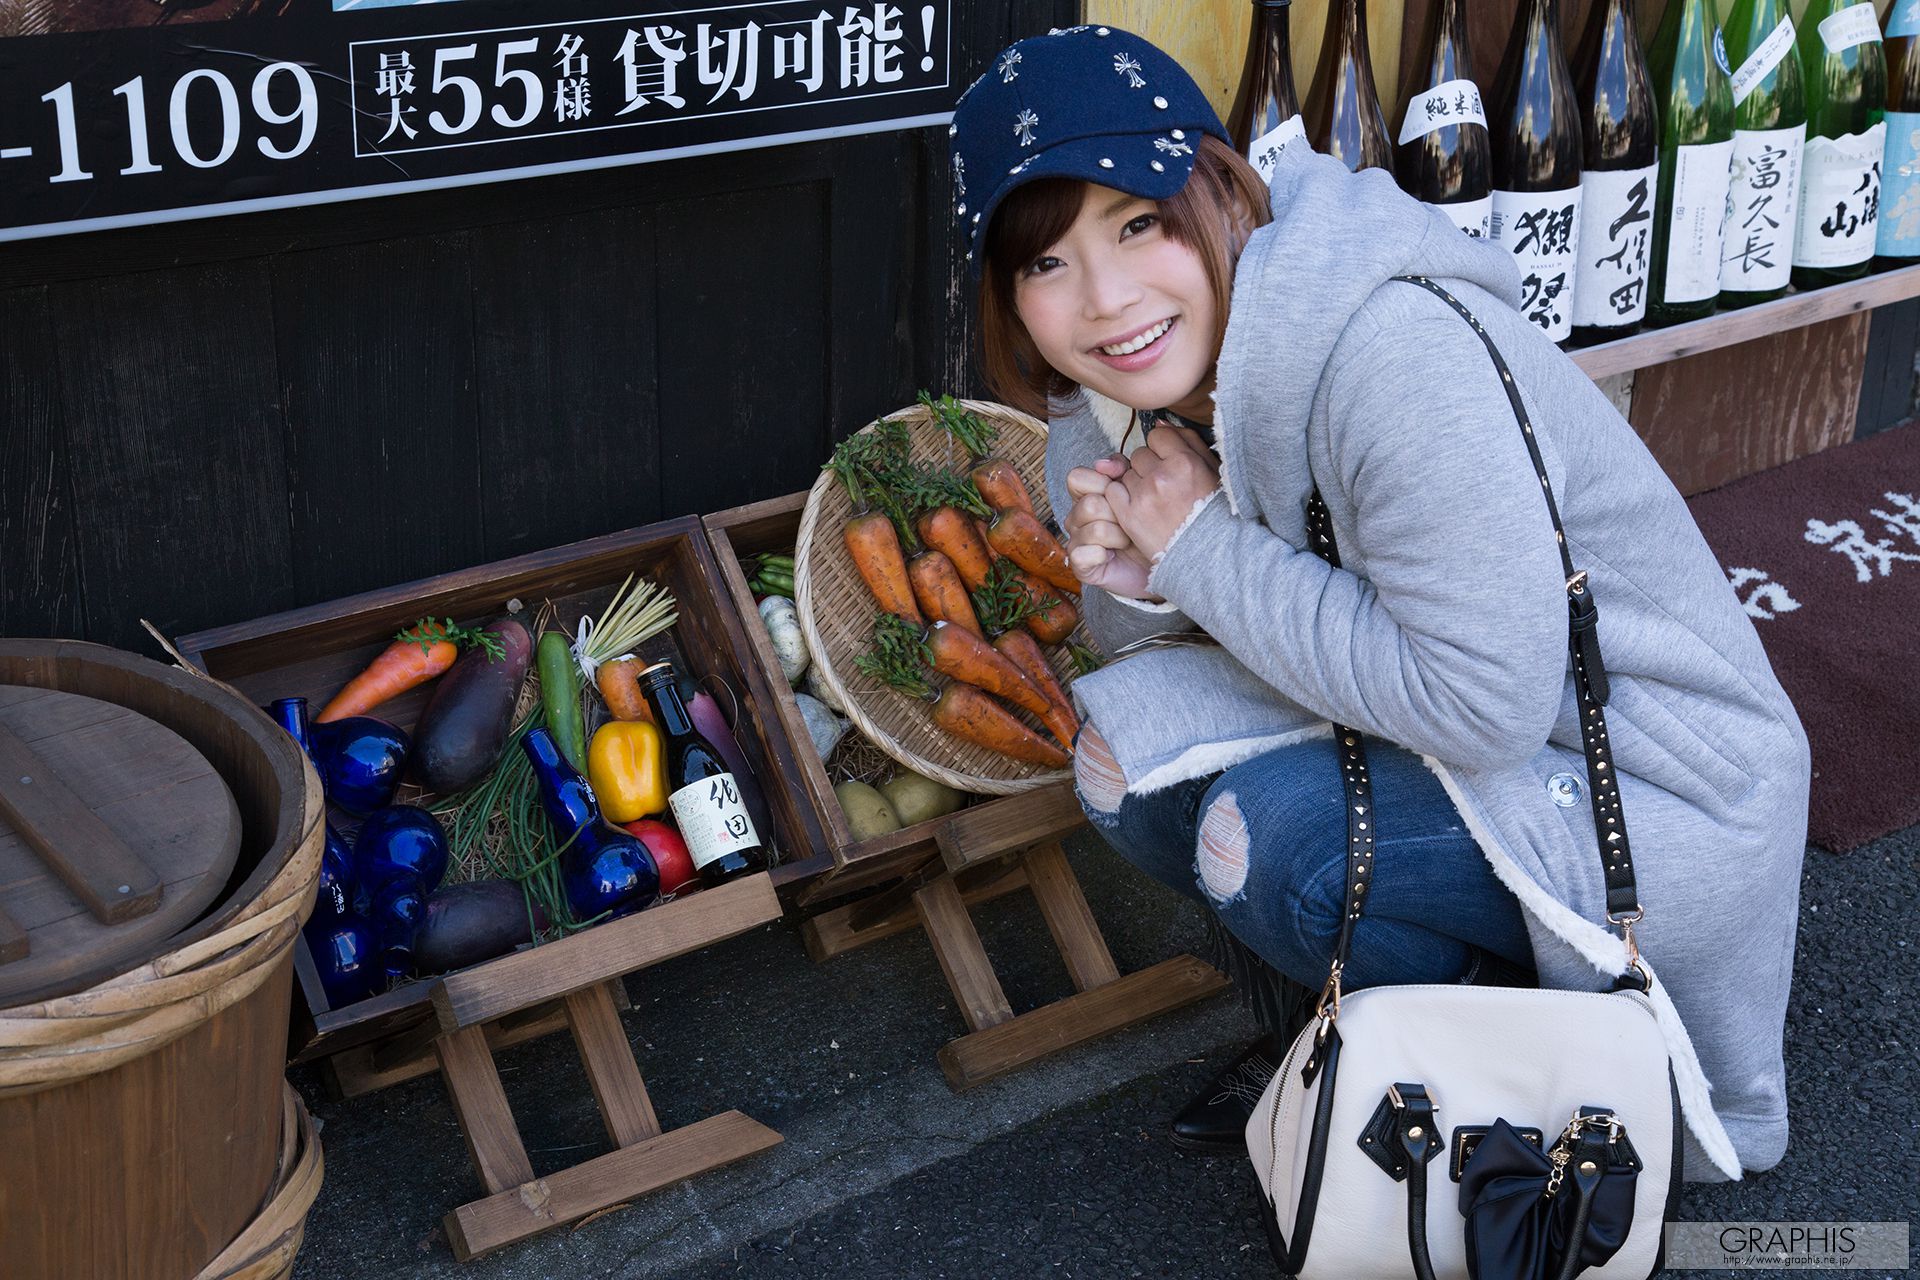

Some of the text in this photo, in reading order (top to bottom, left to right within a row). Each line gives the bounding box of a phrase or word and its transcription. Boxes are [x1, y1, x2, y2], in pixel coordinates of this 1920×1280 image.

[376, 4, 938, 143] 最大 55 名様 貸切可能!
[1425, 90, 1482, 121] 純米酒
[1595, 176, 1650, 315] 久保田
[1728, 144, 1788, 274] 富久長
[1820, 161, 1881, 238] 八海山
[1513, 203, 1575, 330] 獺祭
